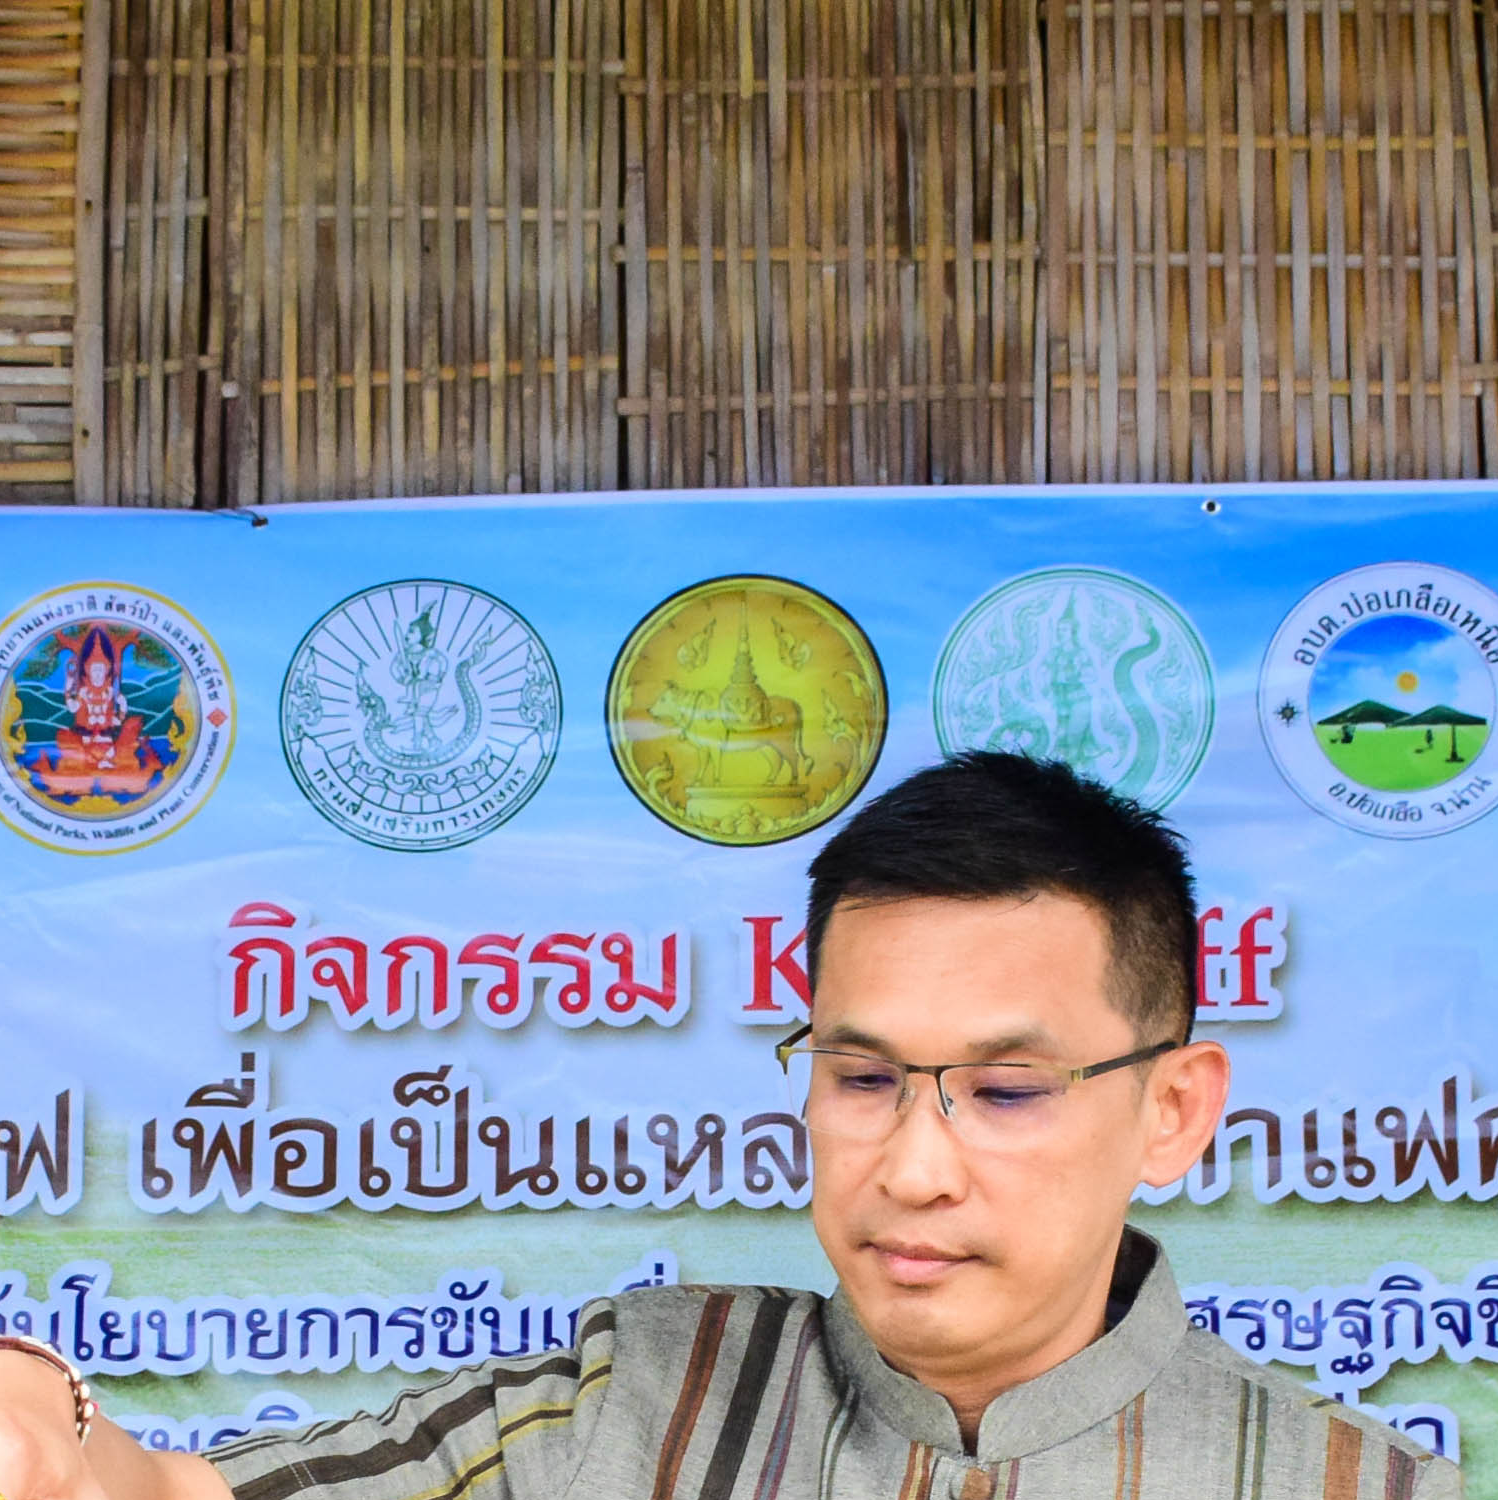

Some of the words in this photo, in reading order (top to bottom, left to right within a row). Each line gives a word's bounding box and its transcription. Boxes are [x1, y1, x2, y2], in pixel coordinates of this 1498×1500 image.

[228, 903, 678, 1018] กิจกรรม
[141, 1052, 809, 1199] เพื่อเป็นแหล
